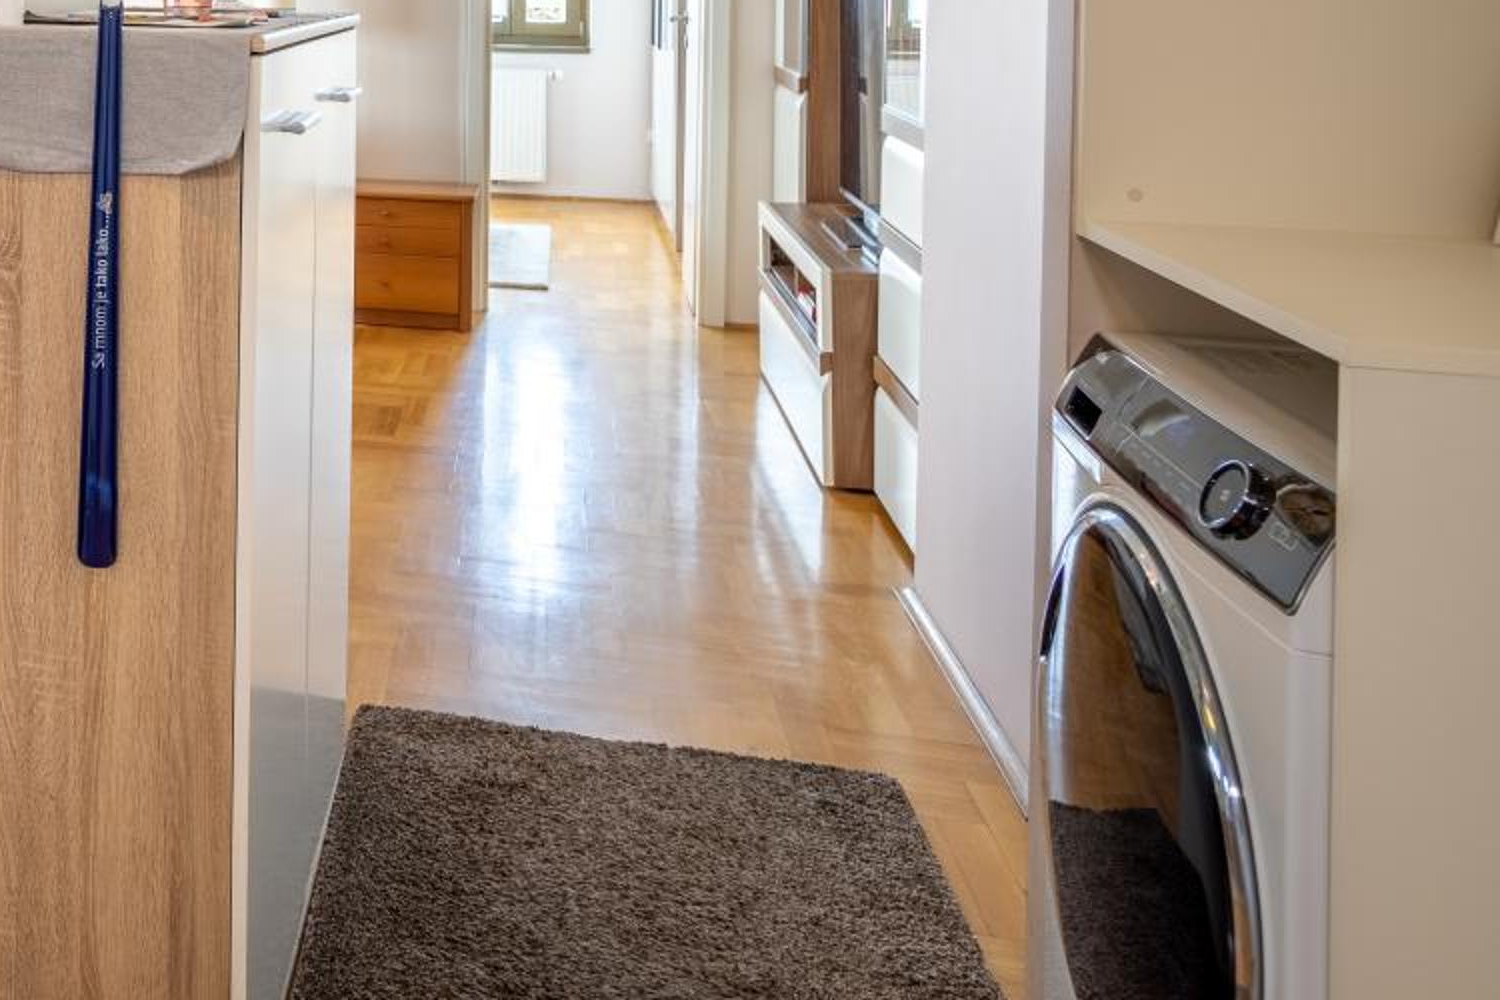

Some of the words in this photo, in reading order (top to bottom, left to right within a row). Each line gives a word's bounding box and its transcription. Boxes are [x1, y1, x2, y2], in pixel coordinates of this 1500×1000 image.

[94, 259, 108, 287] tako
[93, 291, 110, 304] je
[95, 307, 106, 349] mnom
[91, 352, 105, 369] Sa
